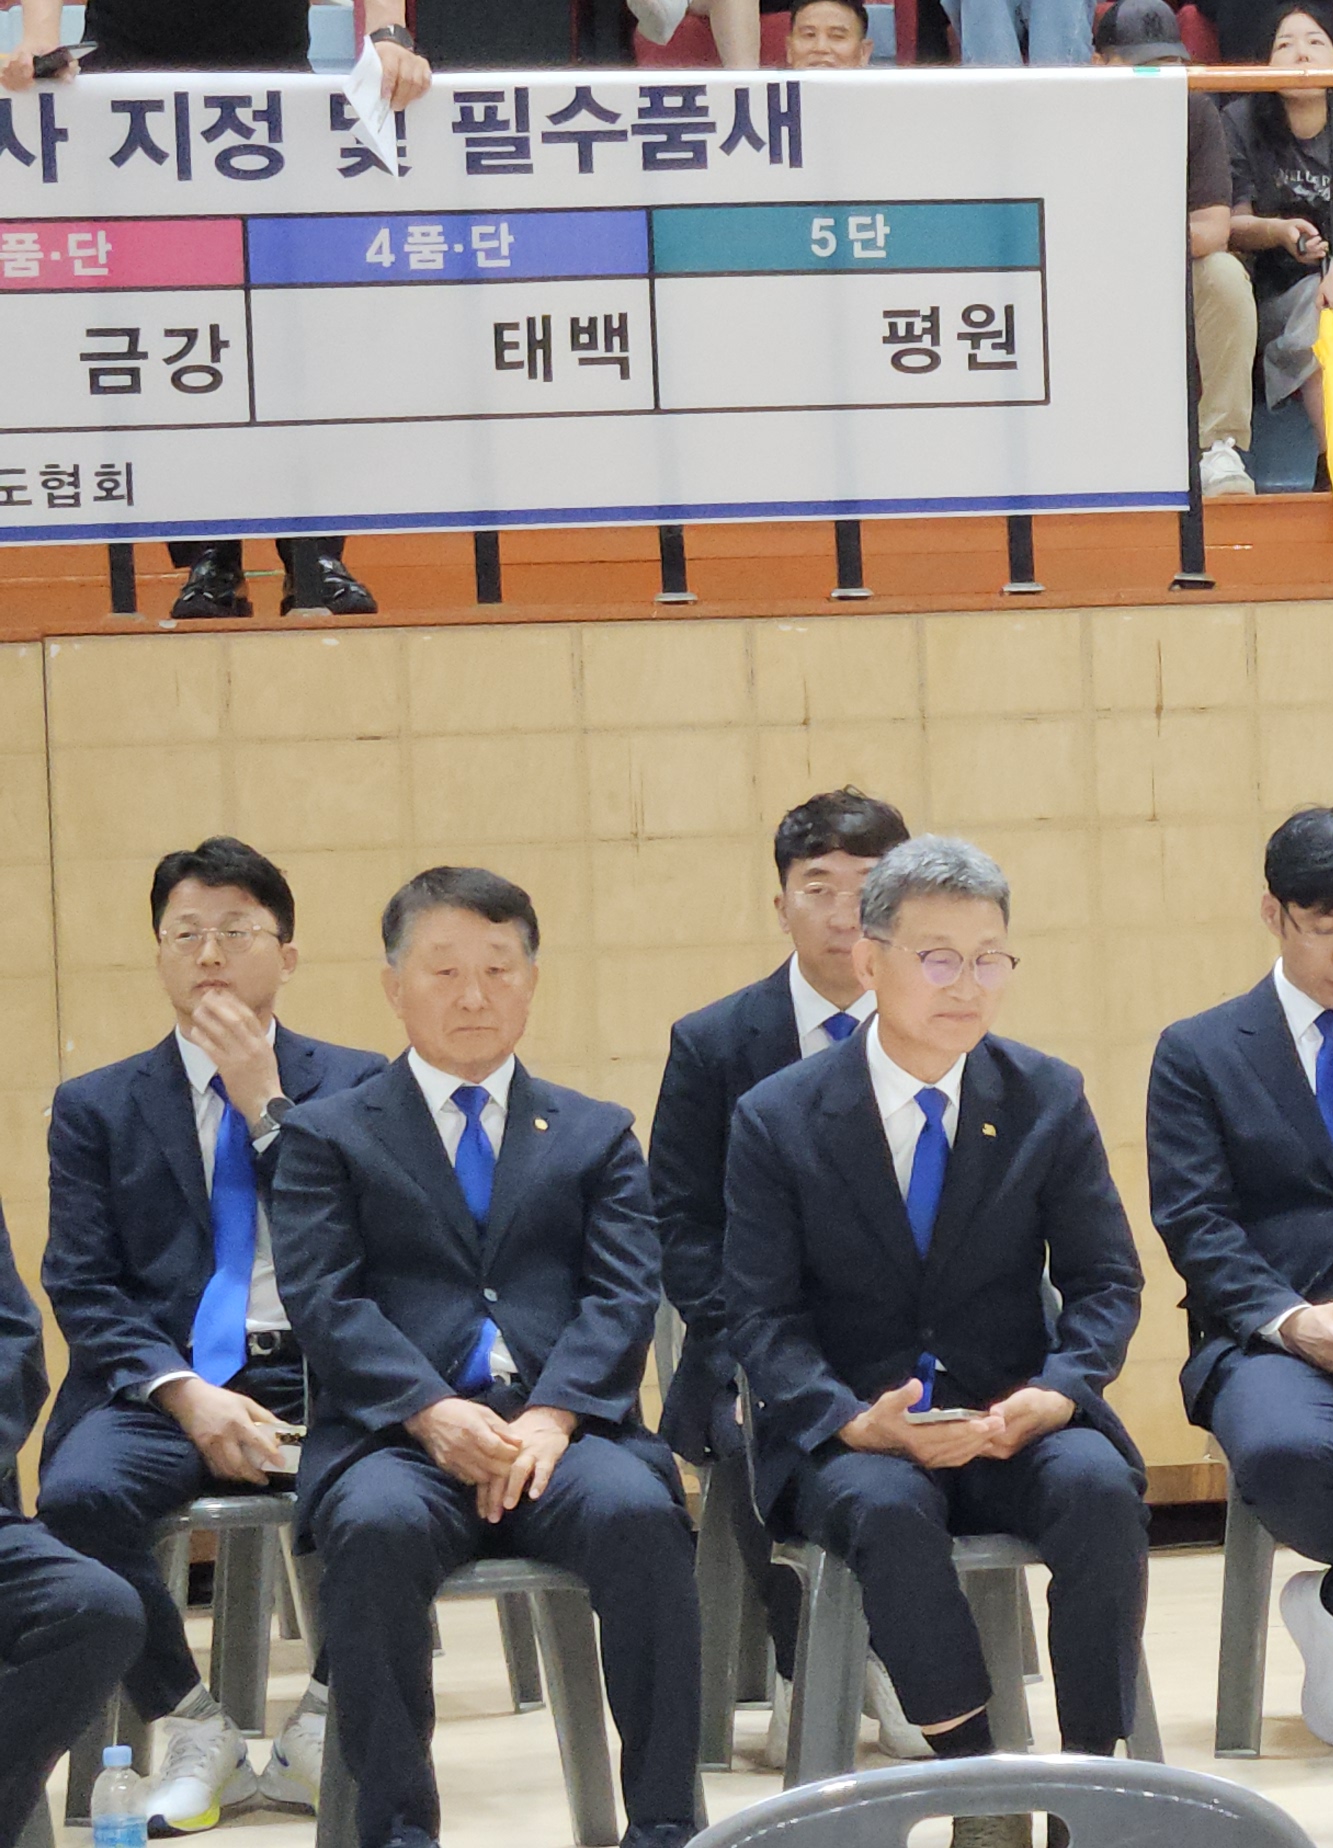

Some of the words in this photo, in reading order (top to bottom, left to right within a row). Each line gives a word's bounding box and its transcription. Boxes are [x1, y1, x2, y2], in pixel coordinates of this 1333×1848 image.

[0, 92, 69, 184] 사
[109, 90, 285, 182] 지정
[451, 80, 804, 176] 필수품새
[365, 221, 516, 271] 4품·단
[809, 212, 891, 260] 5단
[79, 323, 231, 396] 금강
[493, 312, 631, 383] 태백
[882, 302, 1019, 375] 평원
[0, 461, 135, 508] 도협회
